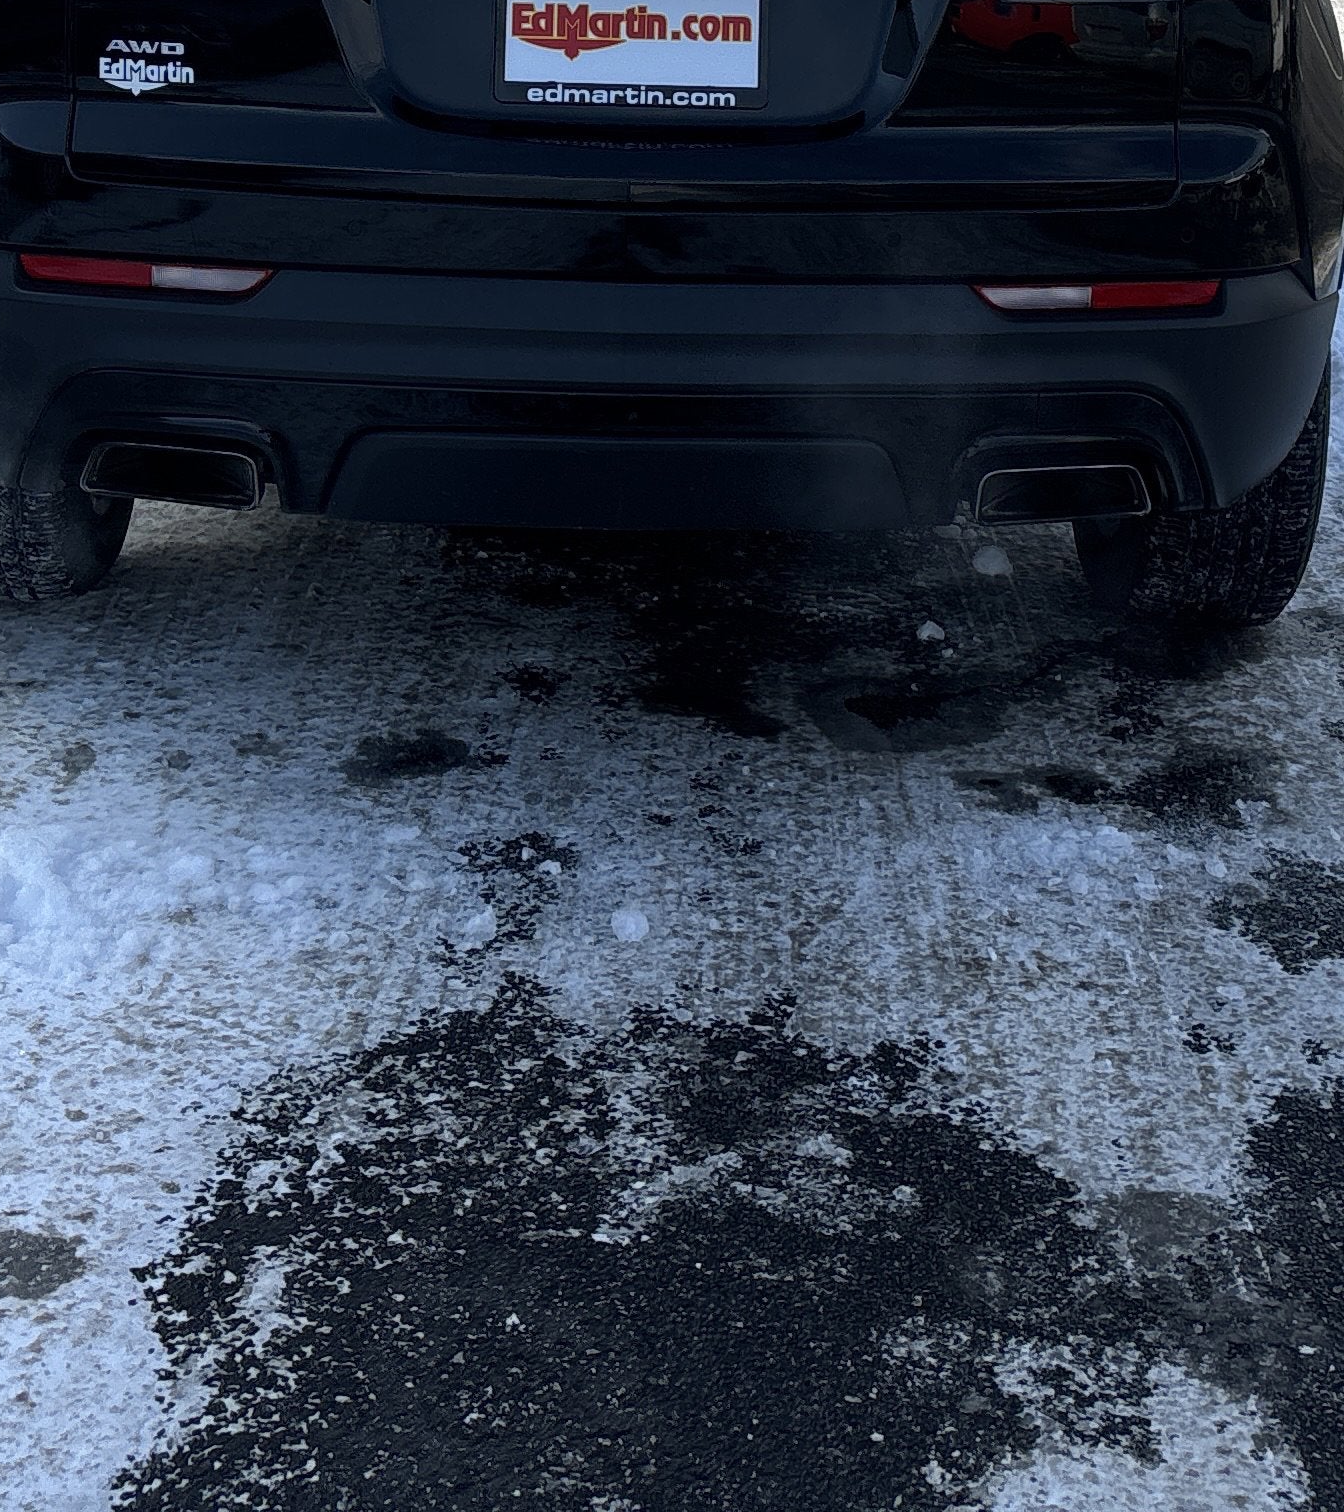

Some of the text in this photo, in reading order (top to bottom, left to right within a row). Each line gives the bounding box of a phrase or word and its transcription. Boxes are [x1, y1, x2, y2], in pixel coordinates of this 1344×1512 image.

[511, 2, 753, 46] EdMartin.com
[106, 39, 185, 55] AWD
[99, 57, 195, 88] EdMartin
[527, 84, 736, 107] edmartin.com
